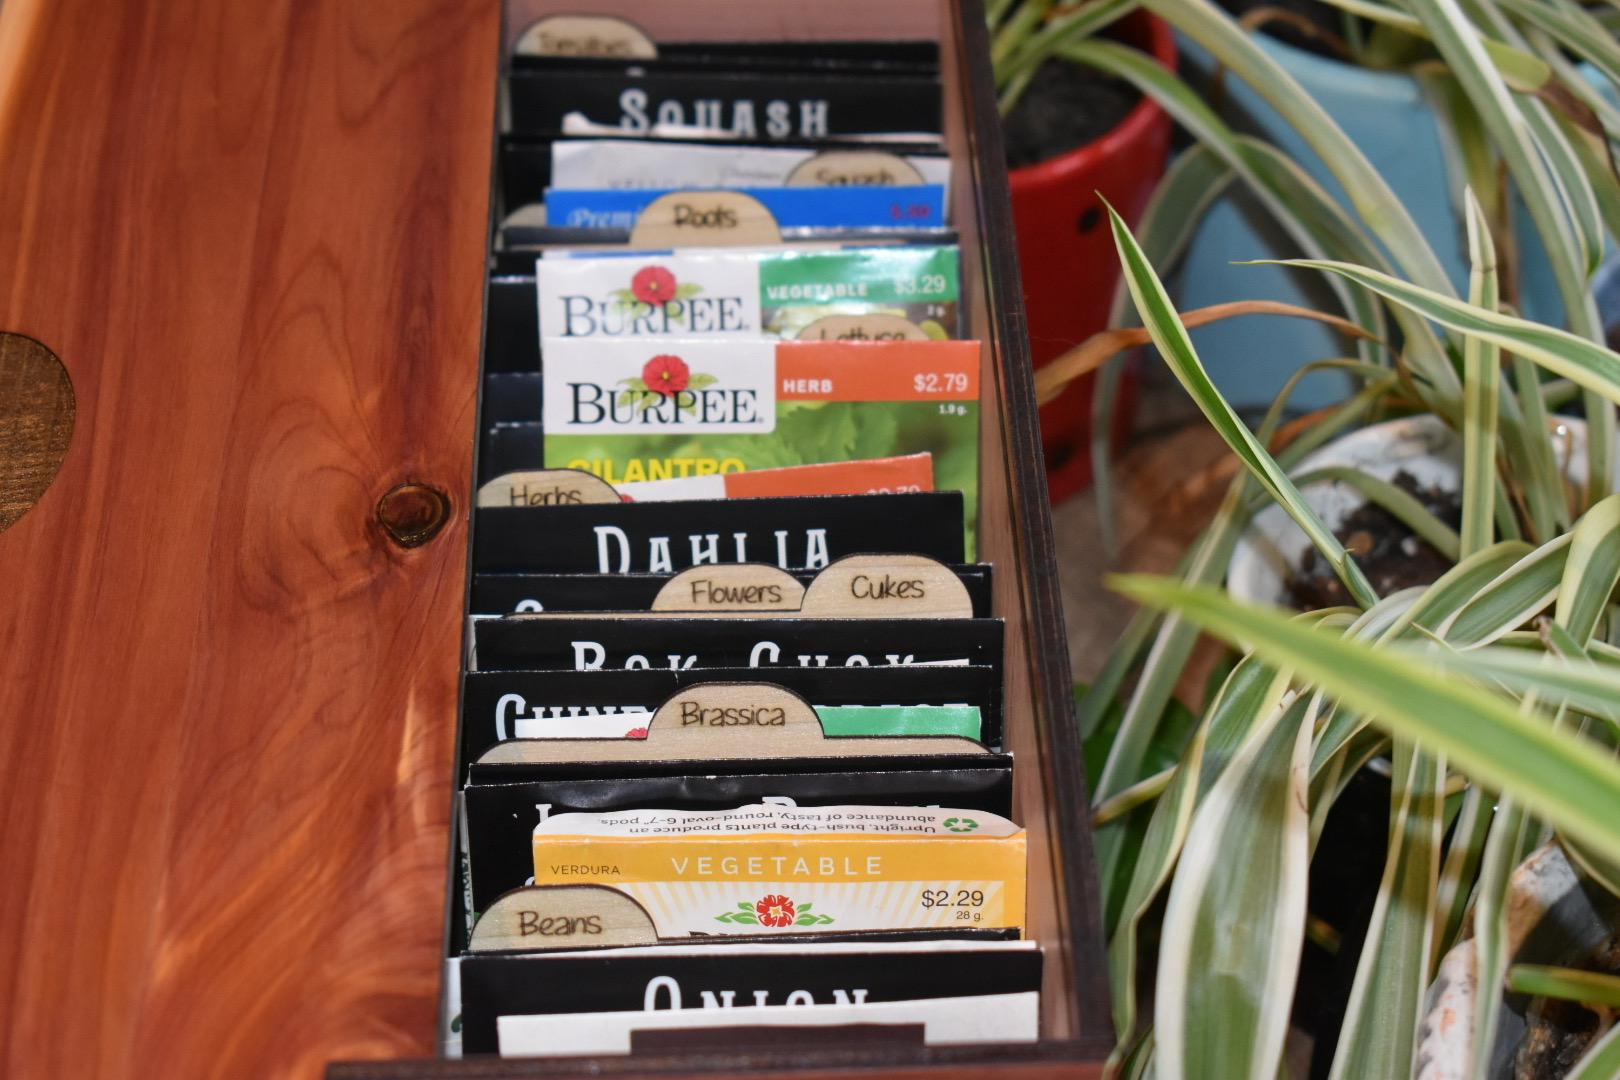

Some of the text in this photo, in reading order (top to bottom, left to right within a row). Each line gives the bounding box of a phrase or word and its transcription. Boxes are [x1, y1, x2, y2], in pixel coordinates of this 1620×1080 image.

[673, 204, 738, 228] Roots
[767, 283, 868, 299] VEGETABLE
[559, 295, 744, 337] BURPEE
[783, 379, 833, 393] HERB
[914, 373, 968, 393] $2.79
[566, 382, 758, 425] BURPEE
[509, 484, 582, 506] Herbs
[690, 580, 782, 604] Flowers
[851, 574, 925, 599] Cukes
[680, 701, 786, 727] Brassica
[682, 811, 773, 825] round-oval
[825, 813, 842, 822] of
[847, 814, 936, 823] abundance
[629, 826, 650, 834] an
[653, 823, 720, 833] produce
[726, 822, 777, 831] plants
[781, 823, 865, 832] bush-type
[551, 865, 621, 875] VERDURA
[672, 856, 882, 875] VEGETABLE
[921, 889, 984, 908] $2.29
[956, 910, 970, 920] 28
[518, 911, 603, 937] Beans
